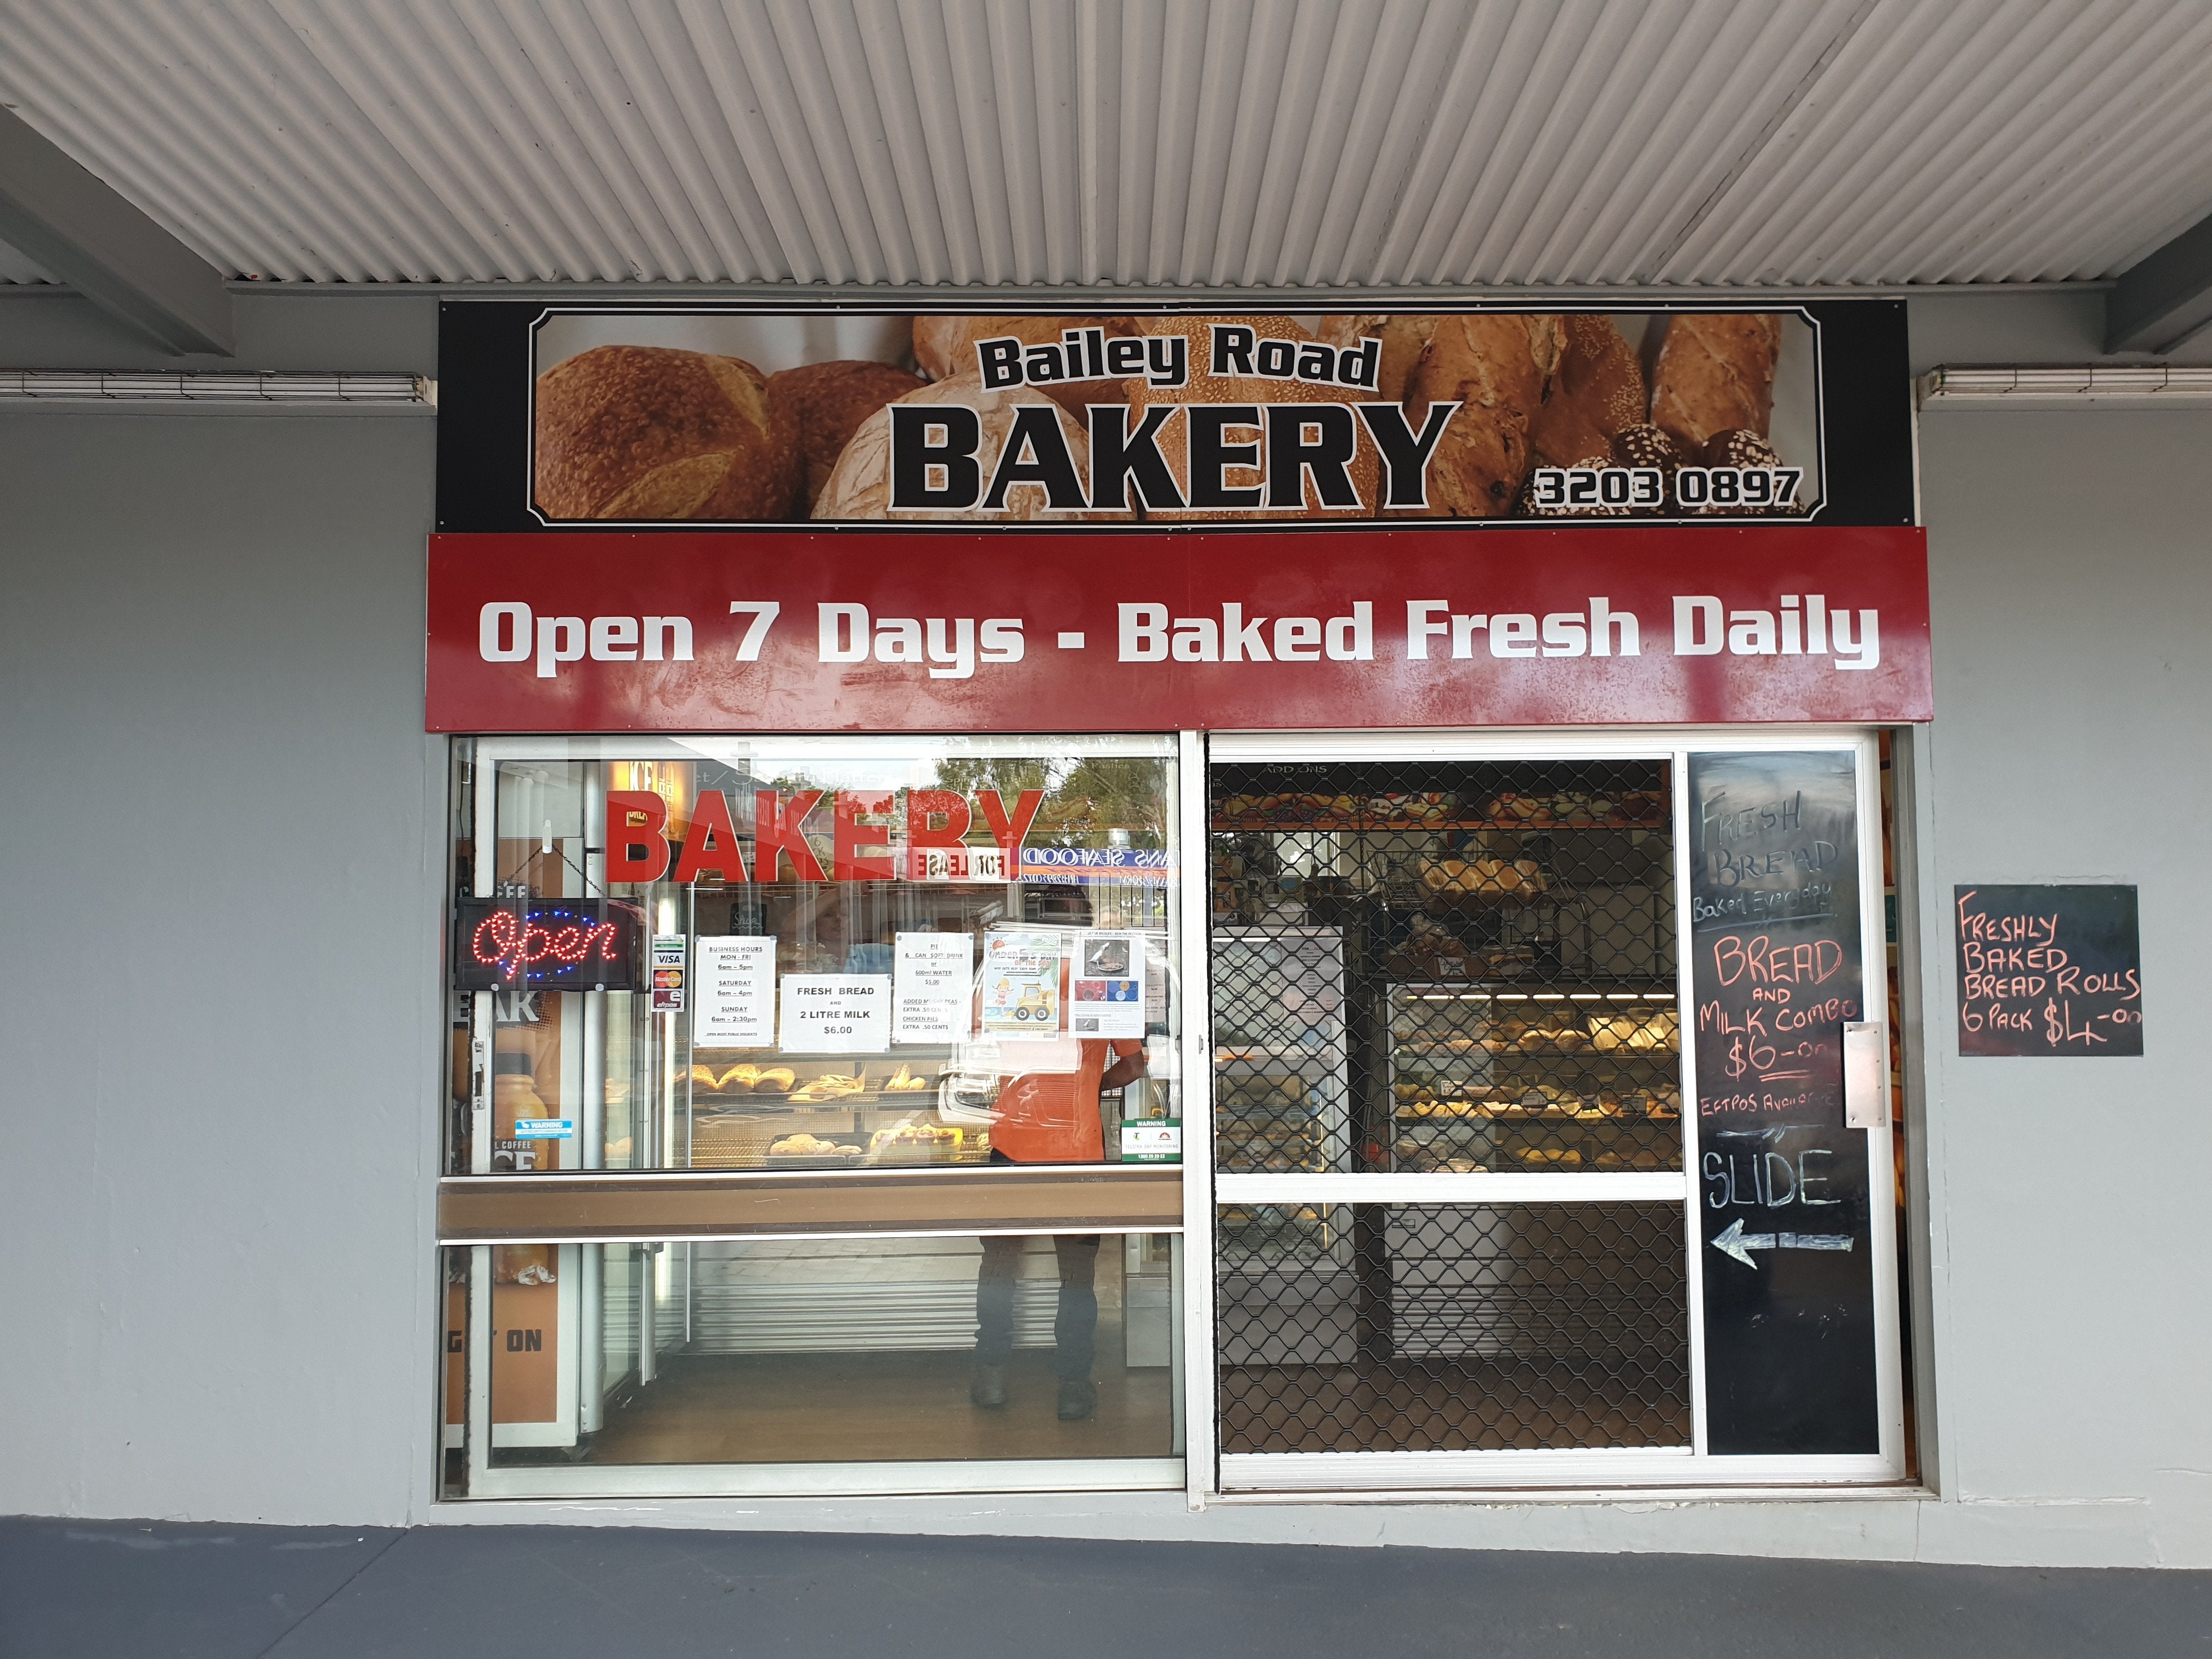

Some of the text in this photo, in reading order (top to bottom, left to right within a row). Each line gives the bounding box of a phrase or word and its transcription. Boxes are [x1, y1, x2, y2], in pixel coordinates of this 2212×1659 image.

[974, 324, 1383, 393] Bailey Road
[887, 402, 1464, 513] BAKERY
[1534, 467, 1804, 507] 3203 0897
[479, 601, 695, 678] Open
[729, 601, 781, 662] 7
[817, 602, 1025, 679] Days
[1118, 600, 1374, 662] Baked
[1406, 596, 1641, 659] Fresh
[1672, 594, 1880, 670] Daily
[605, 789, 1046, 883] BAKERY
[1701, 790, 1802, 851] FRESH
[1713, 841, 1838, 889] BREAD
[1693, 894, 1747, 922] Baked
[1958, 890, 2057, 947] FRESHLY
[472, 911, 617, 981] Open
[657, 955, 680, 963] VISA
[1713, 935, 1843, 986] BREAD
[1963, 941, 2068, 973] BAKED
[1752, 988, 1791, 1004] AND
[1964, 966, 2141, 1001] BREAD ROLLS
[824, 1026, 853, 1035] $6.00
[1700, 1000, 1767, 1037] MILK
[1962, 1001, 1983, 1032] 6
[1989, 1003, 2033, 1032] PACK
[1700, 1093, 1757, 1117] EFTPOS
[502, 1141, 531, 1149] COFFEE
[1703, 1149, 1841, 1209] SLIDE
